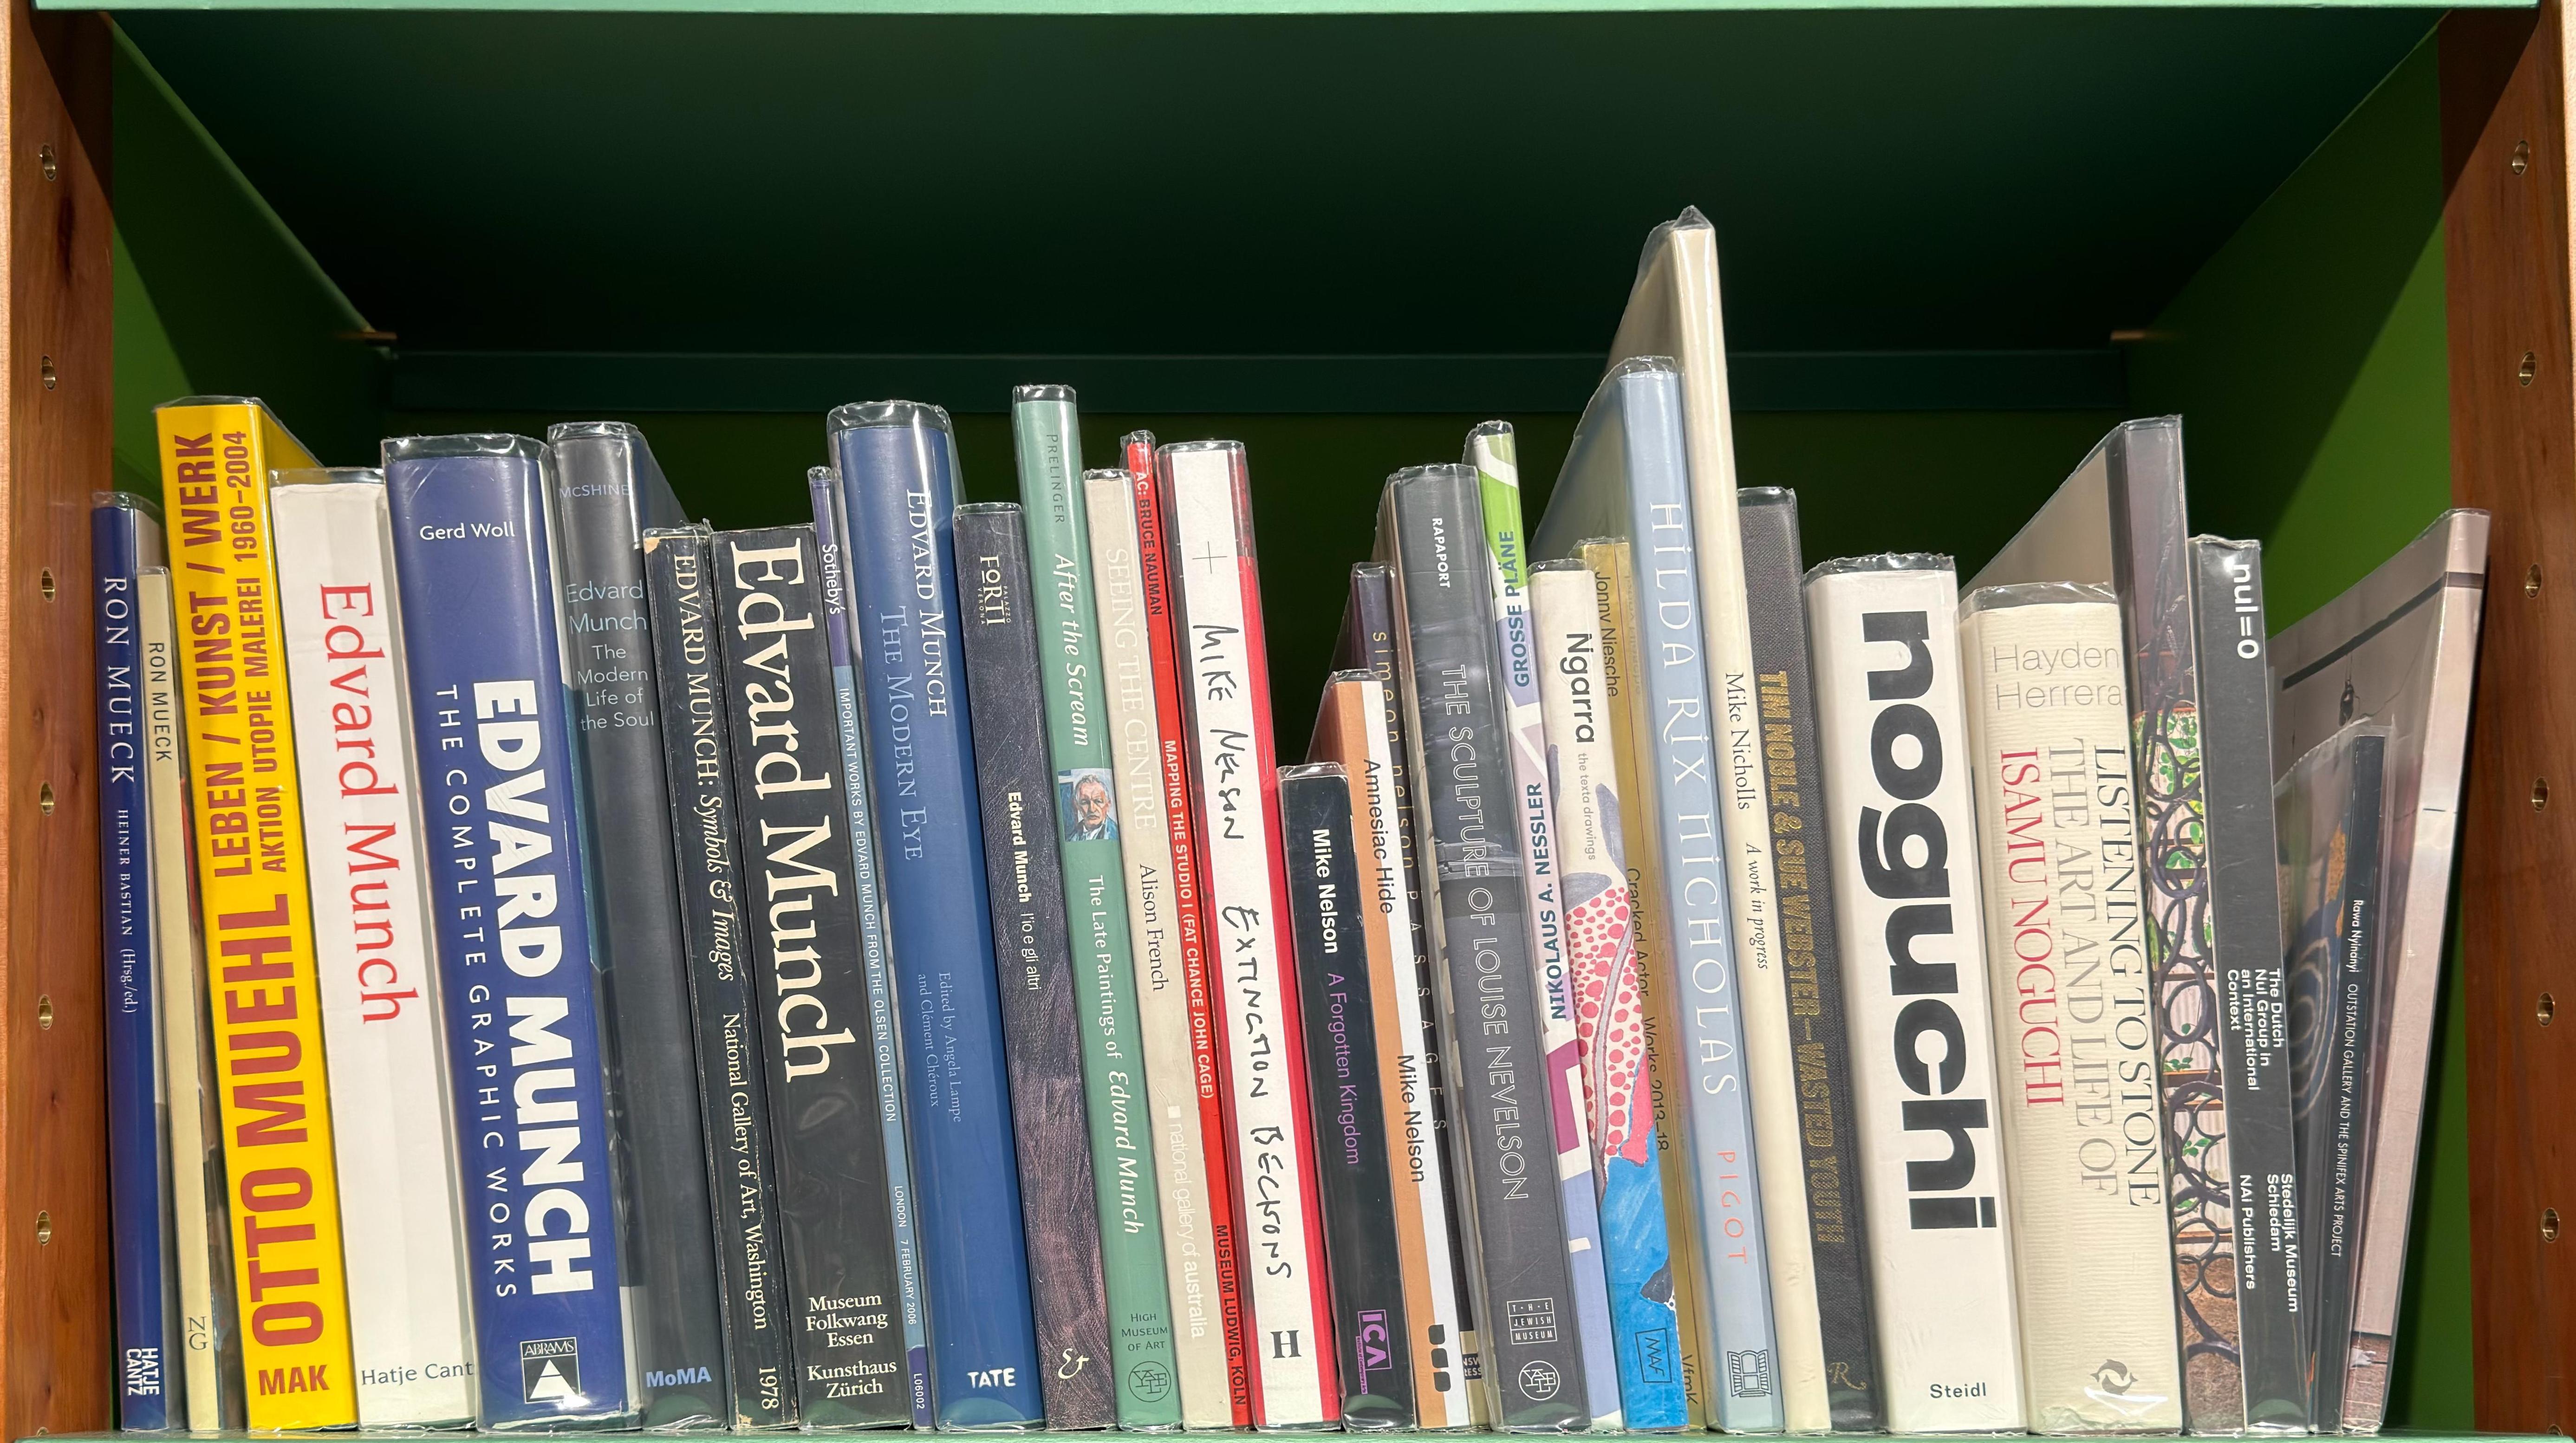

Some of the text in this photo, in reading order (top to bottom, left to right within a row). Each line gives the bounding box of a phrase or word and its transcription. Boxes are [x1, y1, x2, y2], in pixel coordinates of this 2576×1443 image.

[1046, 434, 1064, 523] PRELINGER
[420, 522, 515, 540] Gerd Woll
[1135, 472, 1162, 615] AC: BRUCE NAUMAN
[1432, 518, 1450, 588] RAPAPORT
[236, 578, 269, 677] MALEREI
[566, 580, 644, 603] Edvard
[569, 611, 647, 634] Munch
[674, 553, 706, 664] EDVARD
[1498, 531, 1529, 687] GROSSE PLÄNE
[104, 577, 135, 783] RON MUECK
[578, 669, 648, 683] Modern
[586, 687, 643, 706] Life of
[592, 645, 626, 659] The
[1053, 554, 1089, 746] After the Scream
[1760, 671, 1791, 718] TIM
[1993, 642, 2120, 675] Hayden
[1996, 682, 2123, 710] Herrera
[149, 643, 172, 761] RON MUECK
[247, 691, 278, 773] UTOPIE
[581, 711, 654, 730] the Soul
[687, 673, 720, 786] MUNCH:
[1560, 634, 1596, 860] Ngarra the texta drawings
[118, 810, 130, 864] HEINER
[256, 787, 287, 872] AKTION
[320, 582, 419, 1024] Edvard Munch
[694, 794, 725, 873] Symbols
[730, 538, 856, 1082] Edvard Munch
[1008, 792, 1032, 903] Edvard Munch
[1364, 759, 1395, 914] Amnesiac Hide
[1726, 672, 1768, 969] Mike Nicholls A work in progress
[120, 873, 132, 936] BASTIAN
[174, 433, 324, 1346] OTTO MUEHL LEBEN KUNST WERK
[840, 688, 897, 1122] IMPORTANT WORKS BY EDVARD MUNCH FROM THE OLSEN COLLECTION
[1527, 782, 1566, 1020] NIKOLAUS A. NESSLER
[1777, 839, 1807, 890] SUE
[709, 910, 734, 981] Images
[1140, 864, 1169, 991] Alison French
[1441, 664, 1528, 1200] THE SCULPTURE OF LOUISE NEVELSON
[1782, 895, 1821, 1015] WEBSTER
[1859, 611, 1997, 1230] noguchi
[2001, 749, 2064, 1107] ISAMU NOGUCHI
[2048, 738, 2118, 1196] THE ART AND LIFE OF
[436, 685, 516, 1297] THE COMPLETE GRAPHIC WORKS
[474, 681, 594, 1294] EDVARD MUNCH
[1312, 829, 1361, 1164] Mike Nelson A Forgotten Kingdom
[2094, 745, 2161, 1207] LISTENING TO STONE
[2227, 969, 2241, 1031] Context
[2255, 969, 2270, 1066] Nul Group in
[2269, 968, 2285, 1048] The Dutch
[918, 974, 939, 1107] and Clément Chéroux
[939, 972, 961, 1122] Edited by Angela Lampe
[2241, 969, 2259, 1091] an International
[2331, 899, 2364, 1257] Rawa Nyinanyi OUTSTATION GALLERY AND THE SPINIFEX ARTS PROJECT
[1397, 1054, 1425, 1183] Mike Nelson
[723, 1013, 767, 1330] National Gallery of Art, Washington
[1717, 1151, 1747, 1263] PIGOT
[2267, 1174, 2280, 1252] Schiedam
[2242, 1207, 2256, 1289] Publishers
[2281, 1174, 2298, 1312] Stedelijk Museum
[806, 1313, 888, 1332] Folkwang
[808, 1294, 882, 1312] Museum
[827, 1332, 873, 1347] Essen
[258, 1365, 330, 1396] MAK
[646, 1367, 711, 1387] MoMA
[759, 1367, 778, 1410] 1978
[807, 1360, 897, 1380] Kunsthaus
[826, 1380, 883, 1399] Zürich
[967, 1368, 1016, 1388] TATE
[1930, 1382, 1986, 1398] Steidl
